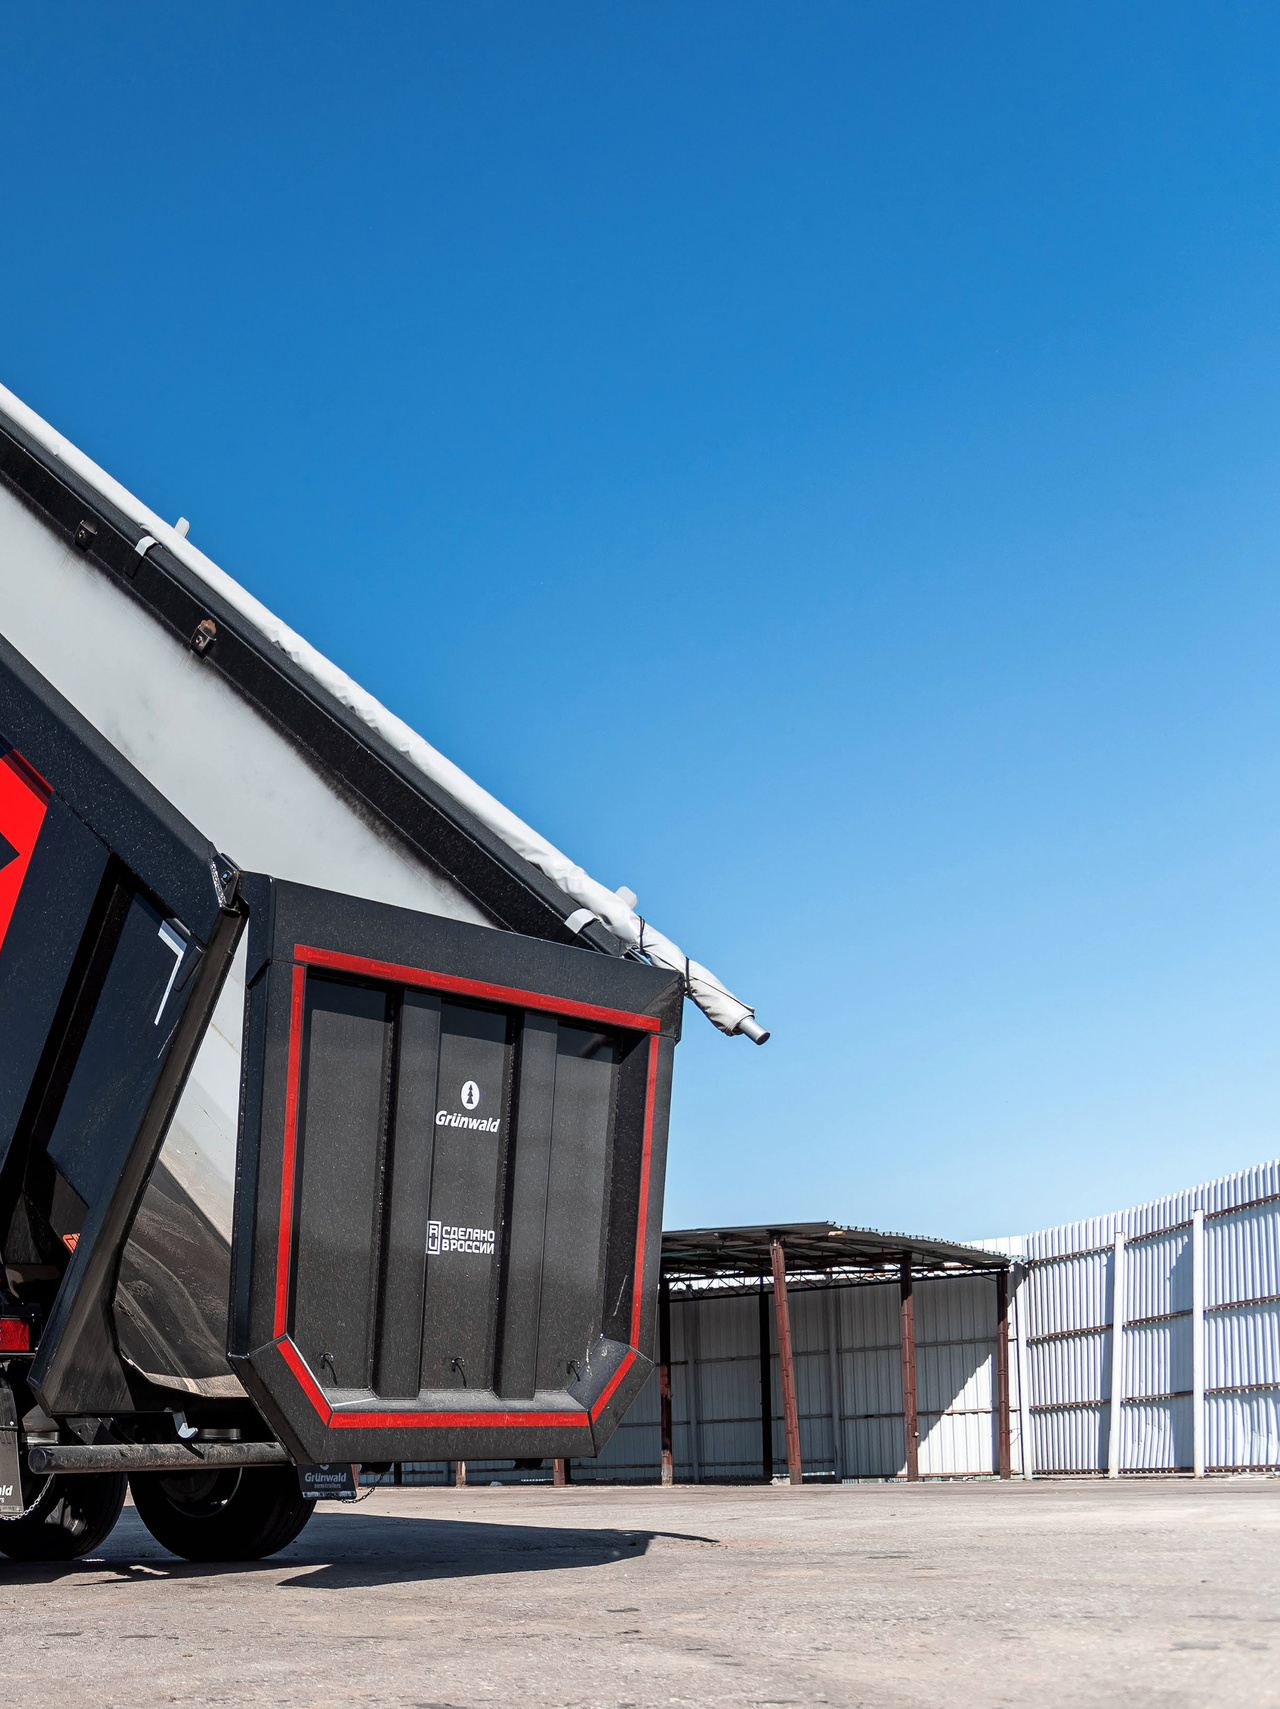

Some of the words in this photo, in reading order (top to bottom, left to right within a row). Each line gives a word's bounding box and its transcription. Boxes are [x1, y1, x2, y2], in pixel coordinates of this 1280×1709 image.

[435, 1110, 501, 1133] Grünwald
[442, 1226, 495, 1242] СДЕЛАНО
[304, 1471, 347, 1483] Grünwald
